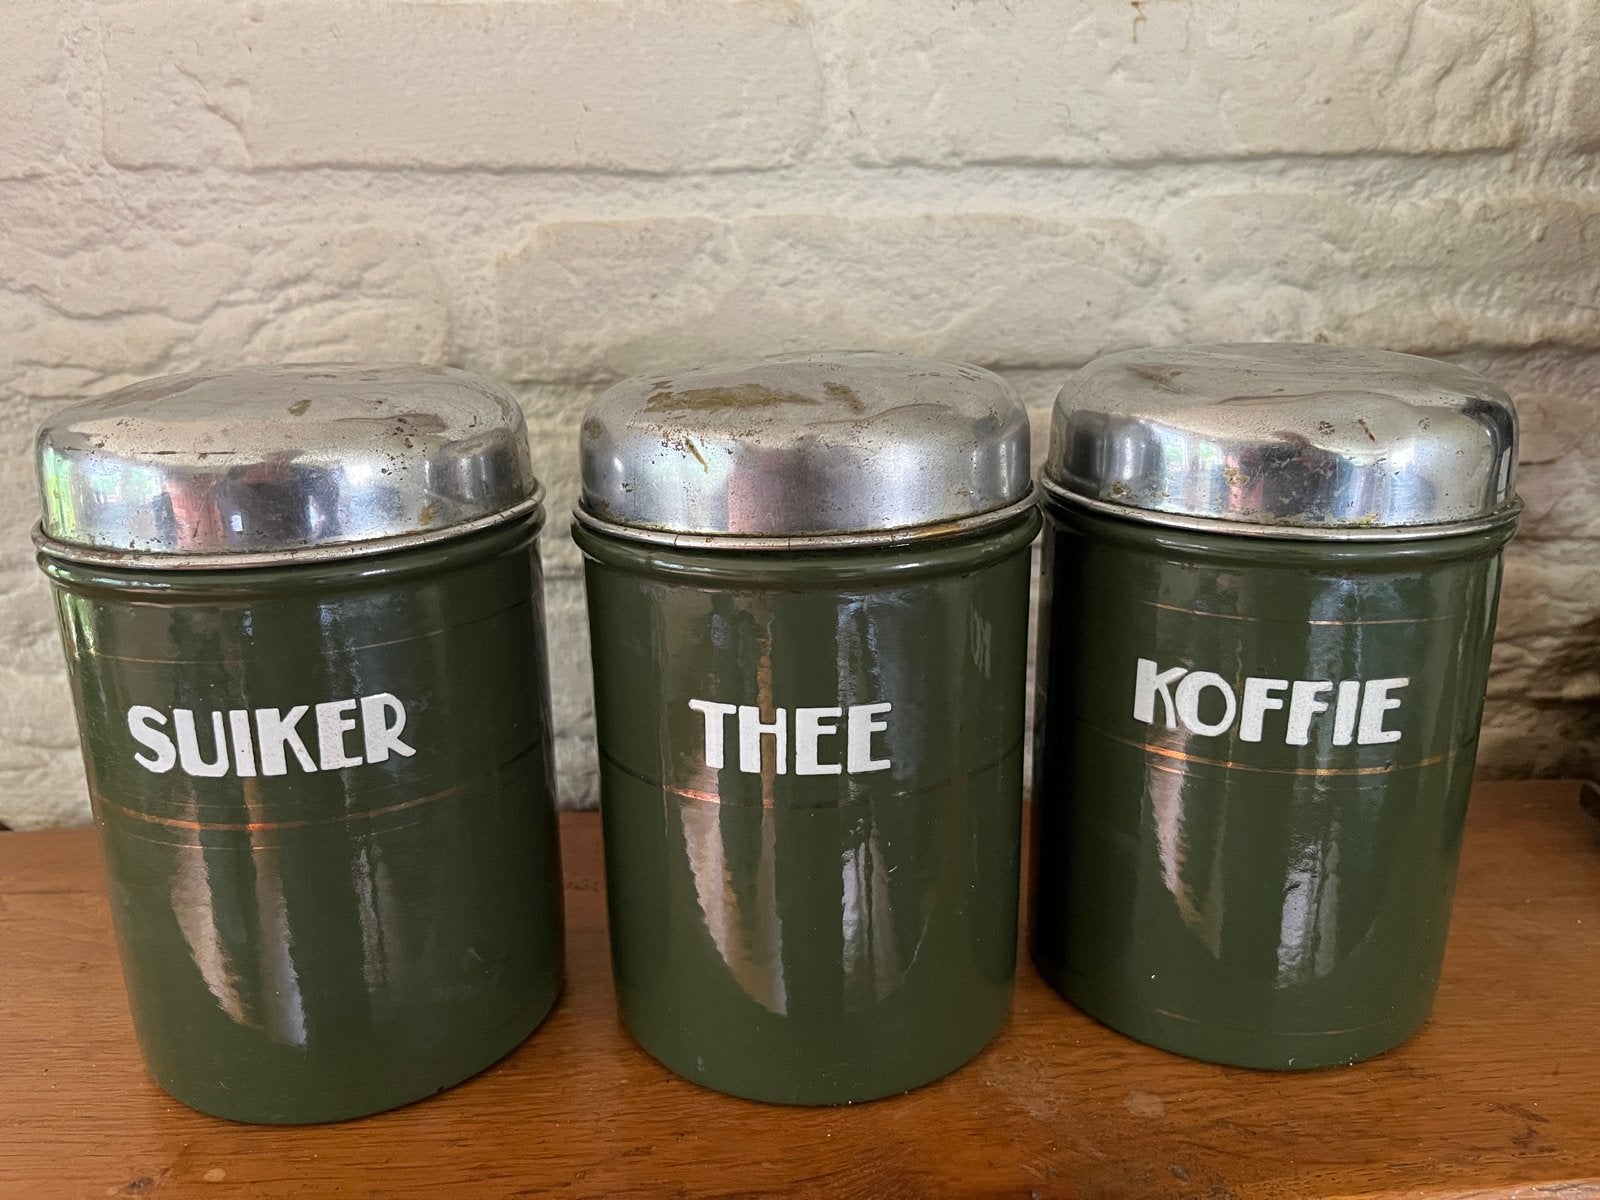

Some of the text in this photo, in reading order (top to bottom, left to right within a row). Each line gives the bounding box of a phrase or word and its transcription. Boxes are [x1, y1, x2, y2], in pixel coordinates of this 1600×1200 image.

[127, 692, 417, 777] SUIKER
[688, 698, 892, 776] THEE
[1133, 658, 1410, 746] KOFFIE
